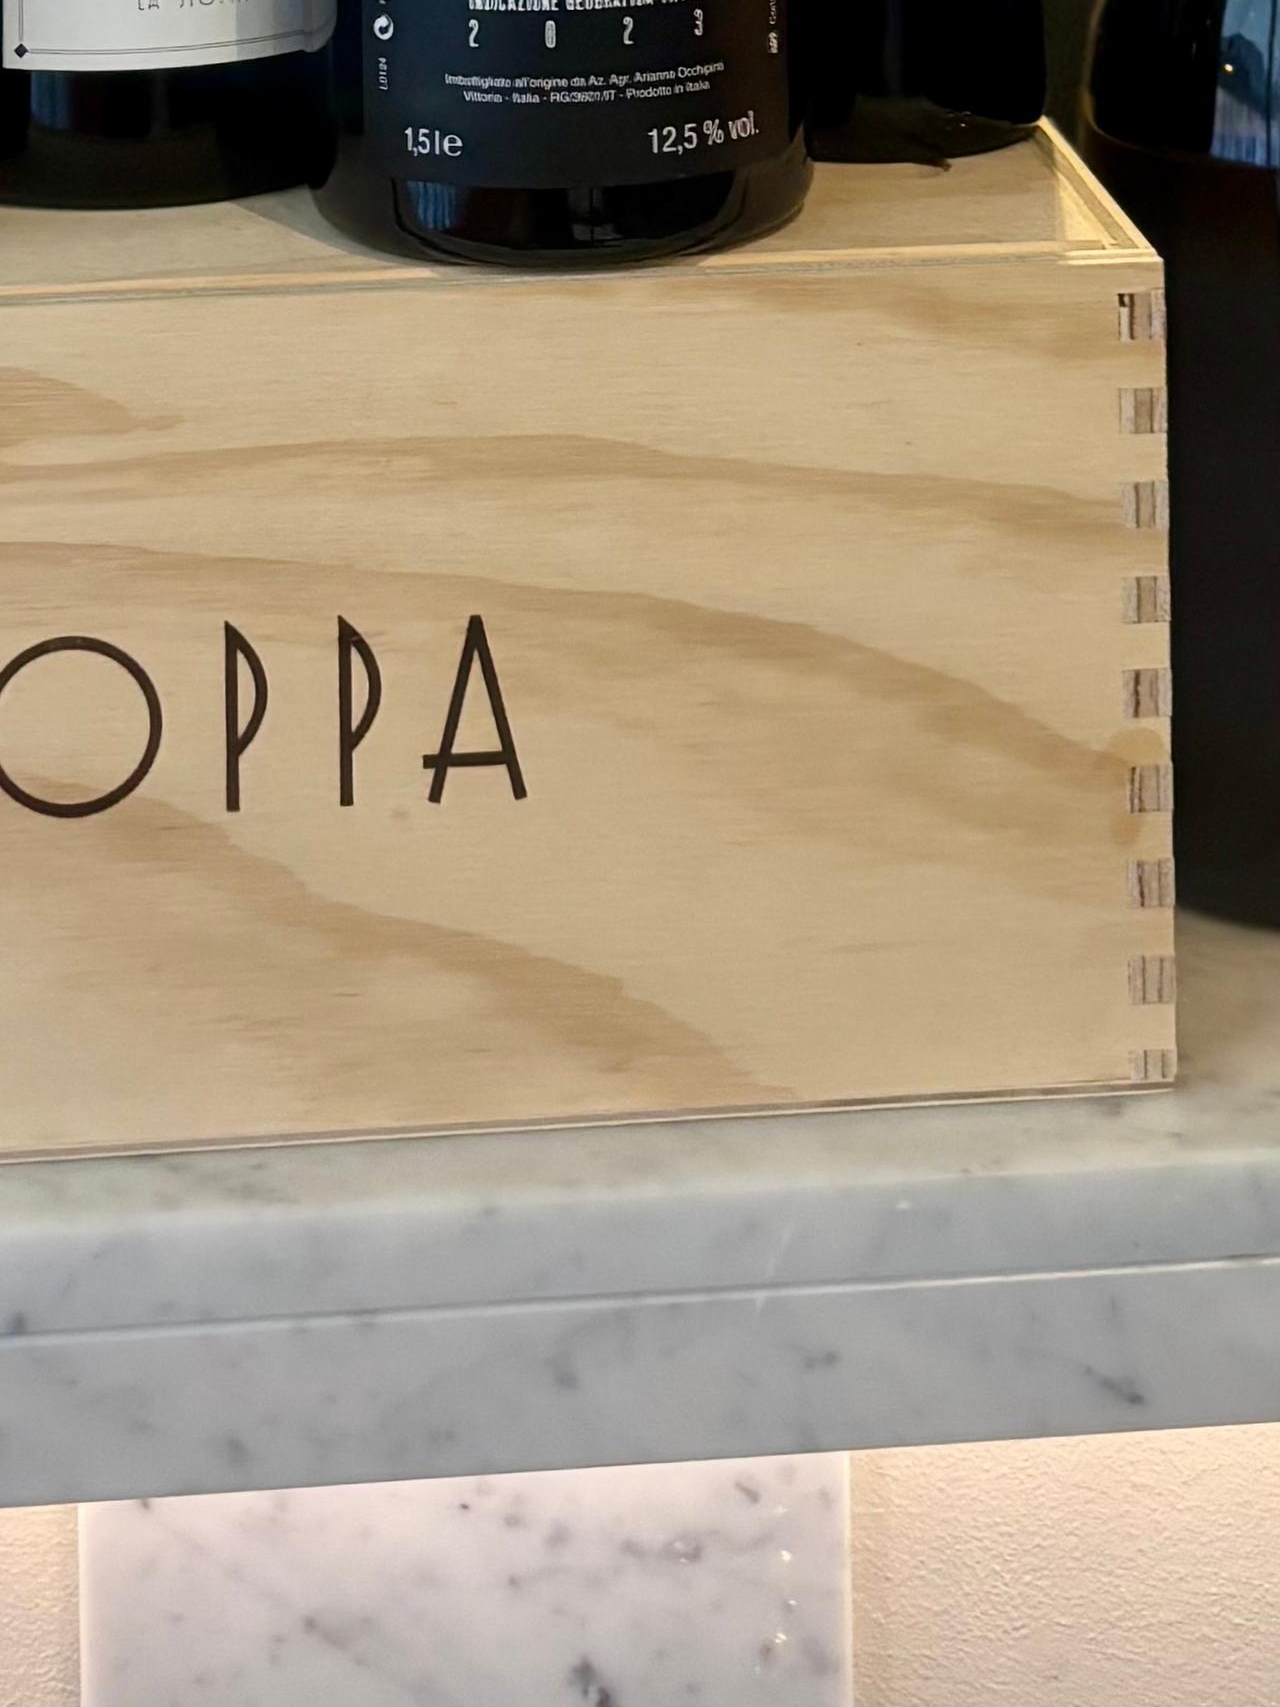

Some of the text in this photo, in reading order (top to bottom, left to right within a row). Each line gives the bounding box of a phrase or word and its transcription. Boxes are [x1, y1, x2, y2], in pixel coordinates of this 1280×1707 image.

[634, 68, 677, 84] Arianna
[647, 122, 698, 157] 12,5
[728, 109, 760, 141] vol.
